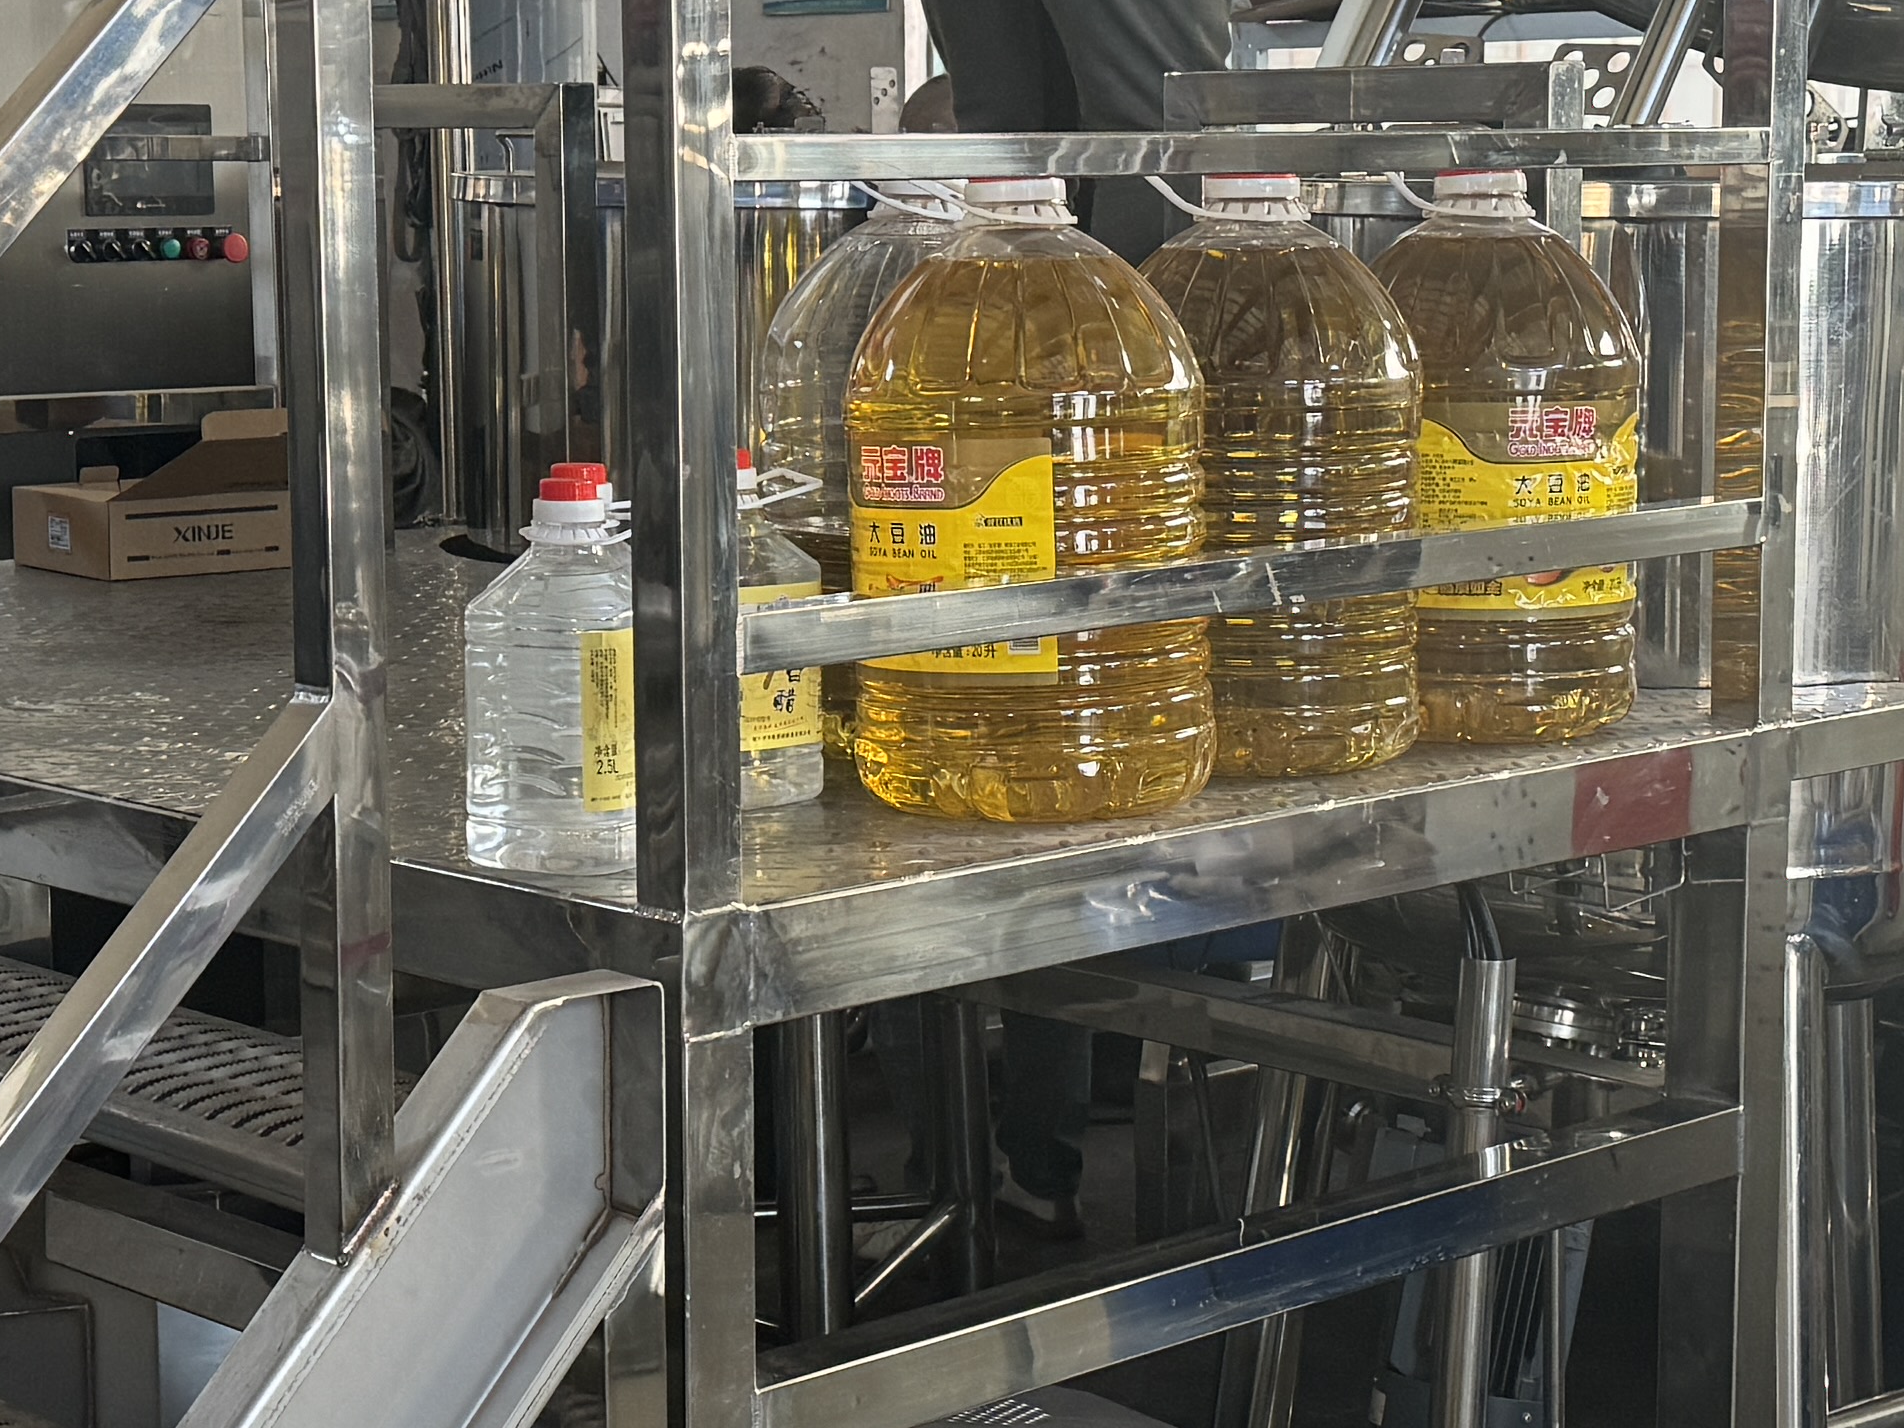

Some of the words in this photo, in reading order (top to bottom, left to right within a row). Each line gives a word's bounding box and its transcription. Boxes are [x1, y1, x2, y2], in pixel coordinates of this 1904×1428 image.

[1509, 405, 1596, 440] 元宝牌
[860, 444, 944, 483] 元宝牌
[1514, 472, 1590, 494] 大豆油
[1513, 498, 1541, 508] SOYA
[1548, 496, 1572, 506] BEAN
[1577, 495, 1590, 505] OIL
[173, 523, 234, 543] XINJE
[869, 521, 936, 545] 大豆油
[892, 548, 915, 559] BEAN
[920, 550, 937, 559] OIL
[596, 759, 620, 775] 2.5L
